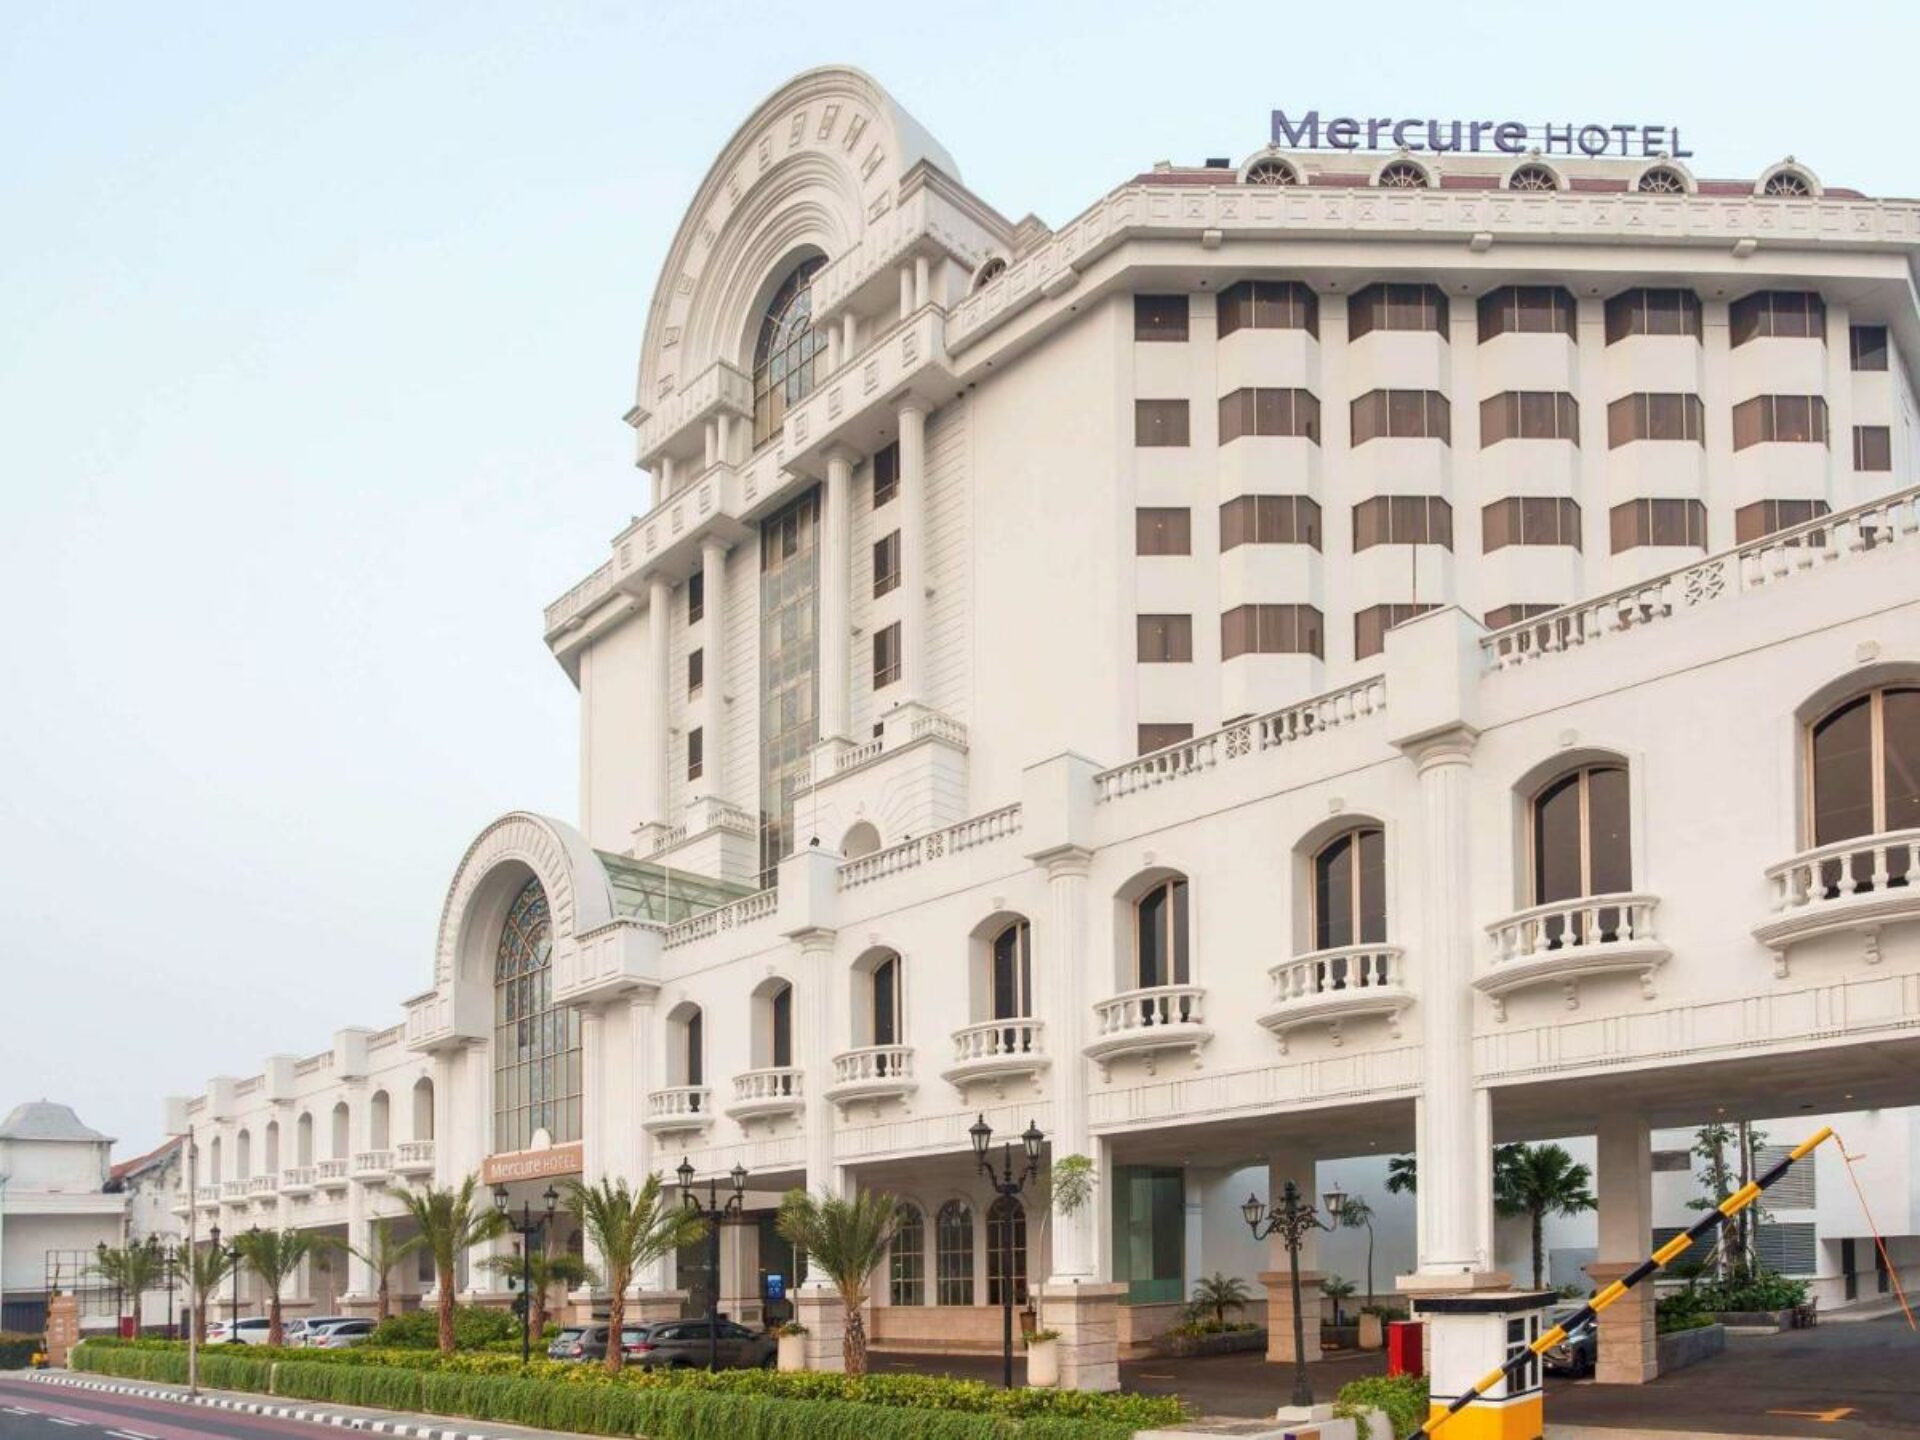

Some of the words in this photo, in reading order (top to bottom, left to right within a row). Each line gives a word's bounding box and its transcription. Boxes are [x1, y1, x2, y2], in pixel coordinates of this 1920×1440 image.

[1271, 110, 1527, 153] Mercure
[1545, 122, 1694, 158] HOTEL
[491, 1161, 542, 1177] Mercure
[543, 1154, 577, 1170] HOTEL
